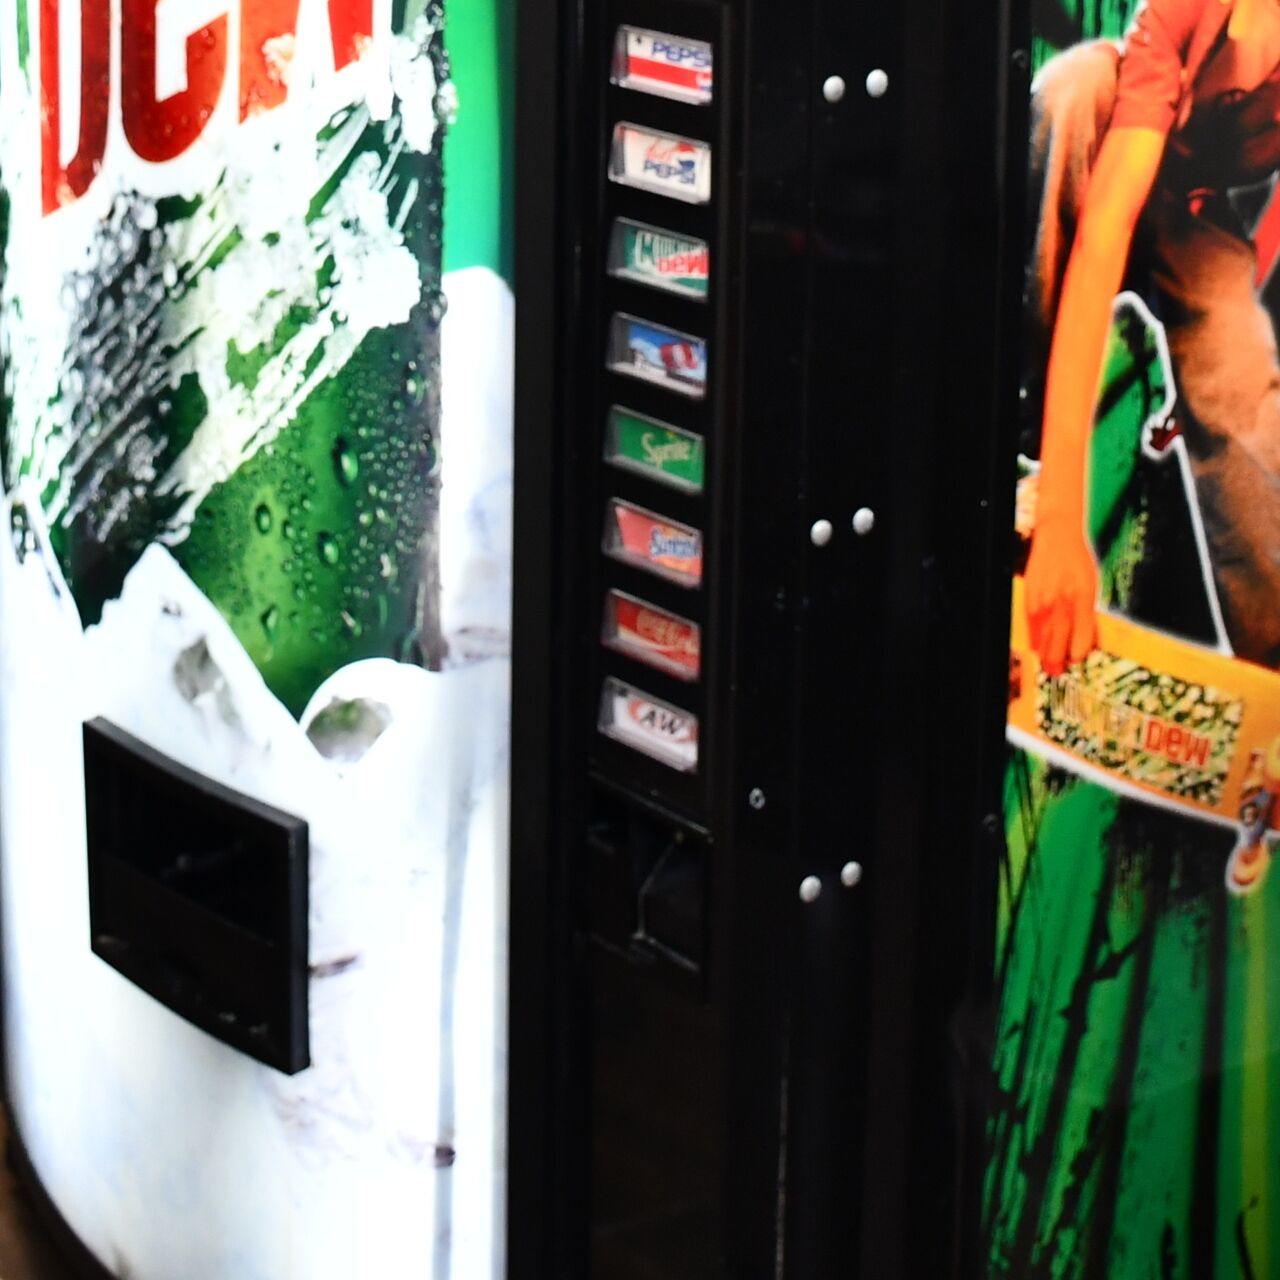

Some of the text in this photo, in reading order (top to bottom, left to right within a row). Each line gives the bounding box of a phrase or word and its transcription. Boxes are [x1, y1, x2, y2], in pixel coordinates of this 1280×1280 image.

[652, 38, 712, 68] PEPS
[644, 157, 696, 186] PEPSI
[642, 431, 689, 471] Sprite
[640, 707, 686, 736] AW
